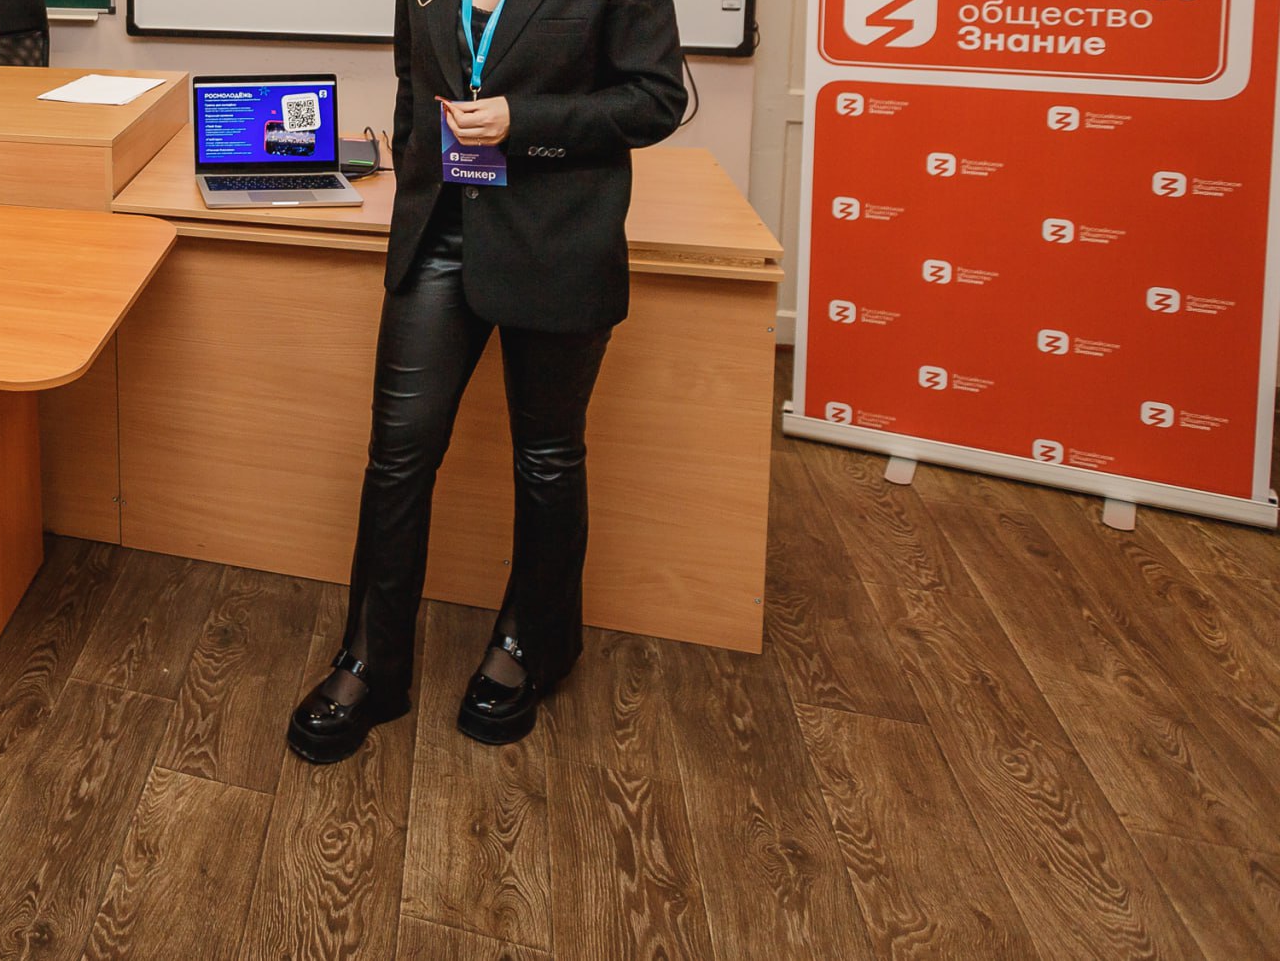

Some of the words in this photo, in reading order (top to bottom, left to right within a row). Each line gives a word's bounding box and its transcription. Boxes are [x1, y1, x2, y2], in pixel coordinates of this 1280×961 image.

[958, 0, 1153, 29] общество
[957, 25, 1106, 56] Знание
[451, 167, 496, 181] Спикер
